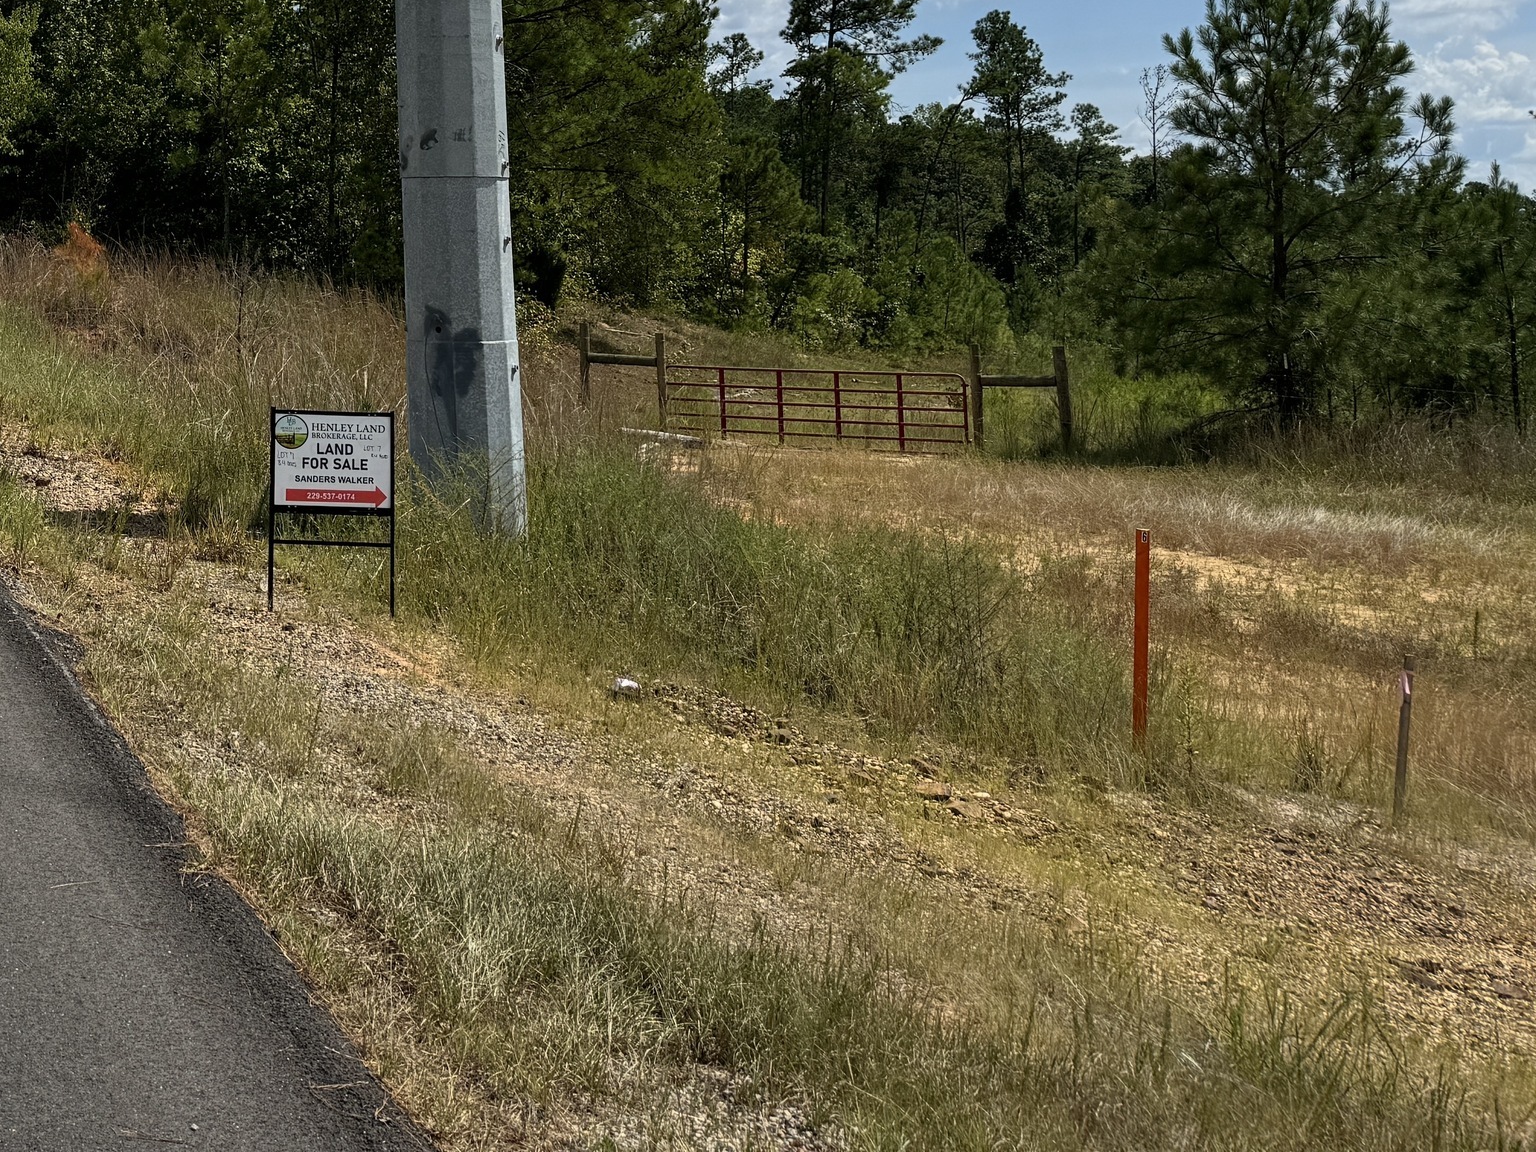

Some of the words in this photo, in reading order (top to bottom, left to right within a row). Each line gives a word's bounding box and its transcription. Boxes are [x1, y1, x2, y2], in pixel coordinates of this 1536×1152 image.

[311, 422, 354, 433] HENLEY
[356, 424, 386, 434] LAND
[311, 432, 358, 441] BROKERAGE,
[316, 442, 354, 455] LAND
[302, 457, 329, 470] FOR
[333, 458, 369, 471] SALE
[294, 475, 336, 483] SANDERS
[337, 476, 375, 485] WALKER
[306, 492, 356, 501] 229-537-0174
